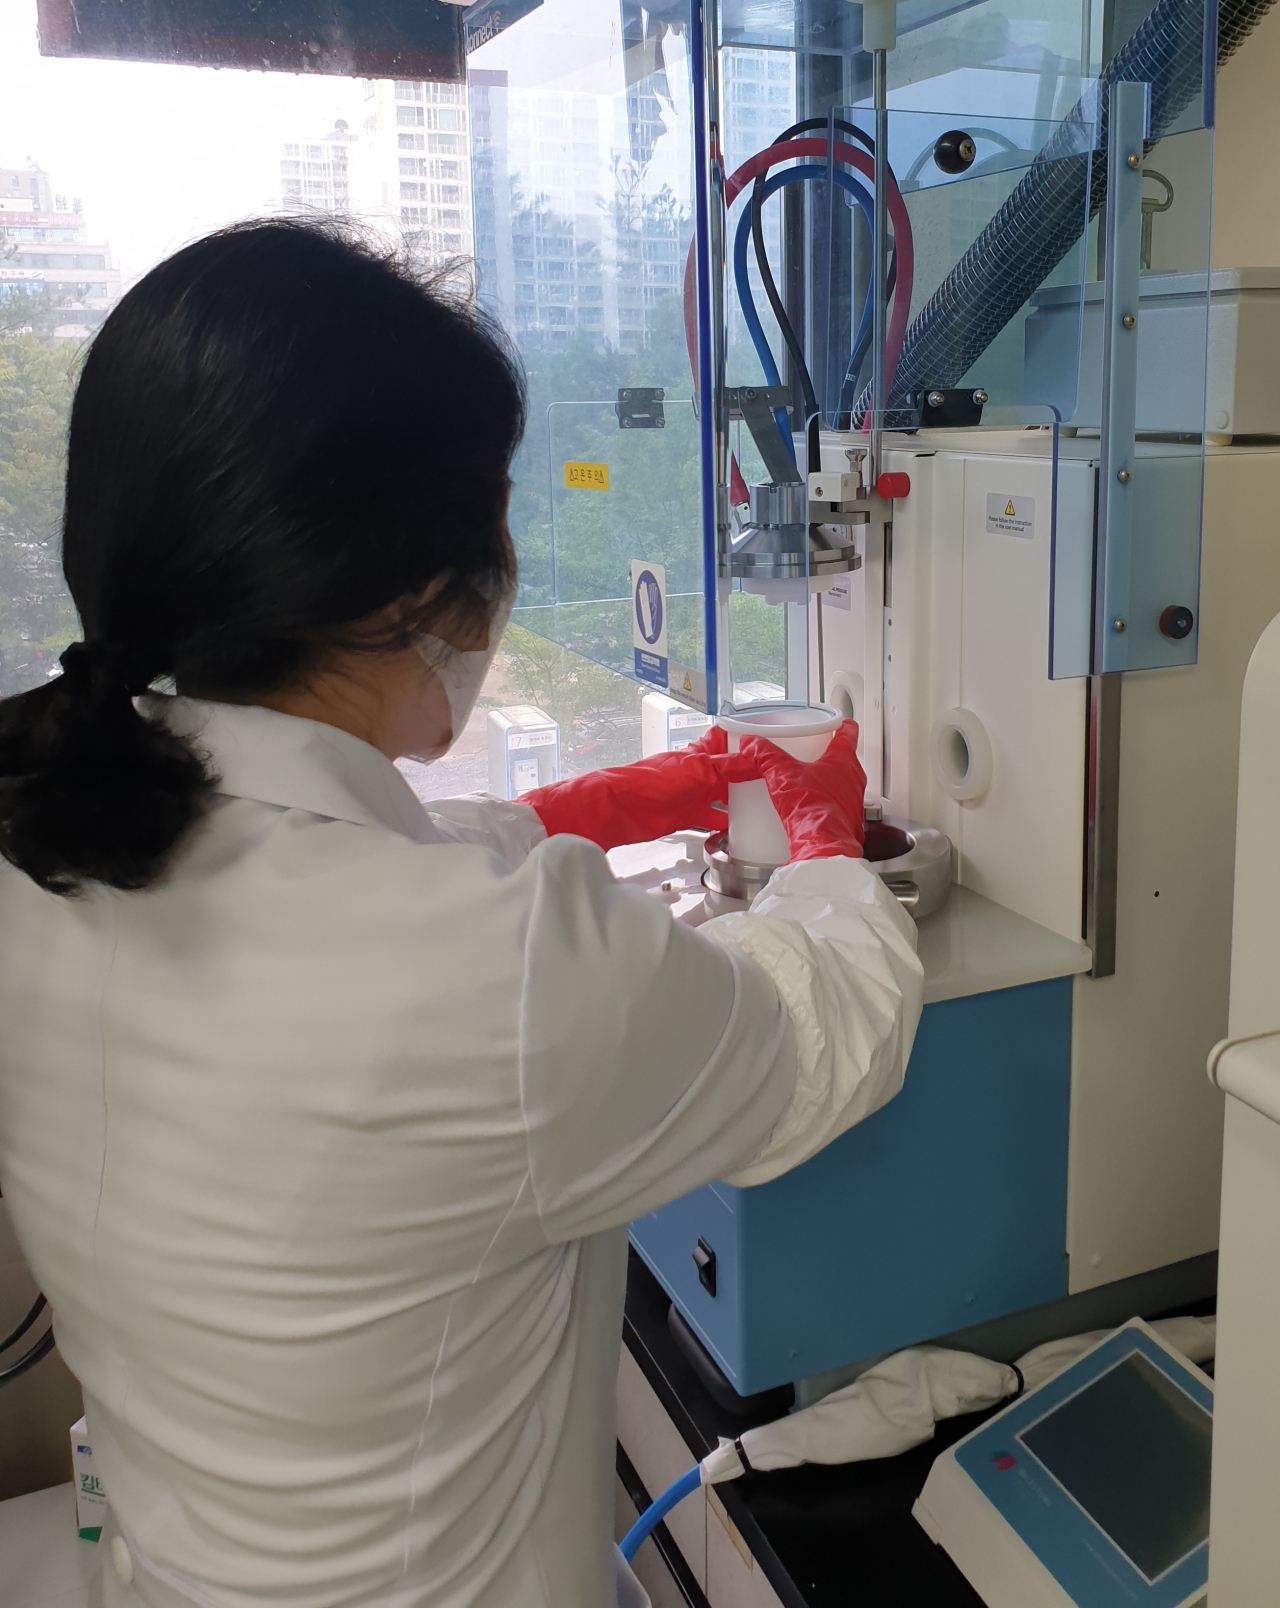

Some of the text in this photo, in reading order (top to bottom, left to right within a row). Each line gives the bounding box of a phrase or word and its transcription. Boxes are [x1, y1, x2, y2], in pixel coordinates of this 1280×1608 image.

[574, 468, 599, 482] 고온주의
[675, 716, 682, 728] 6
[515, 736, 522, 747] 7
